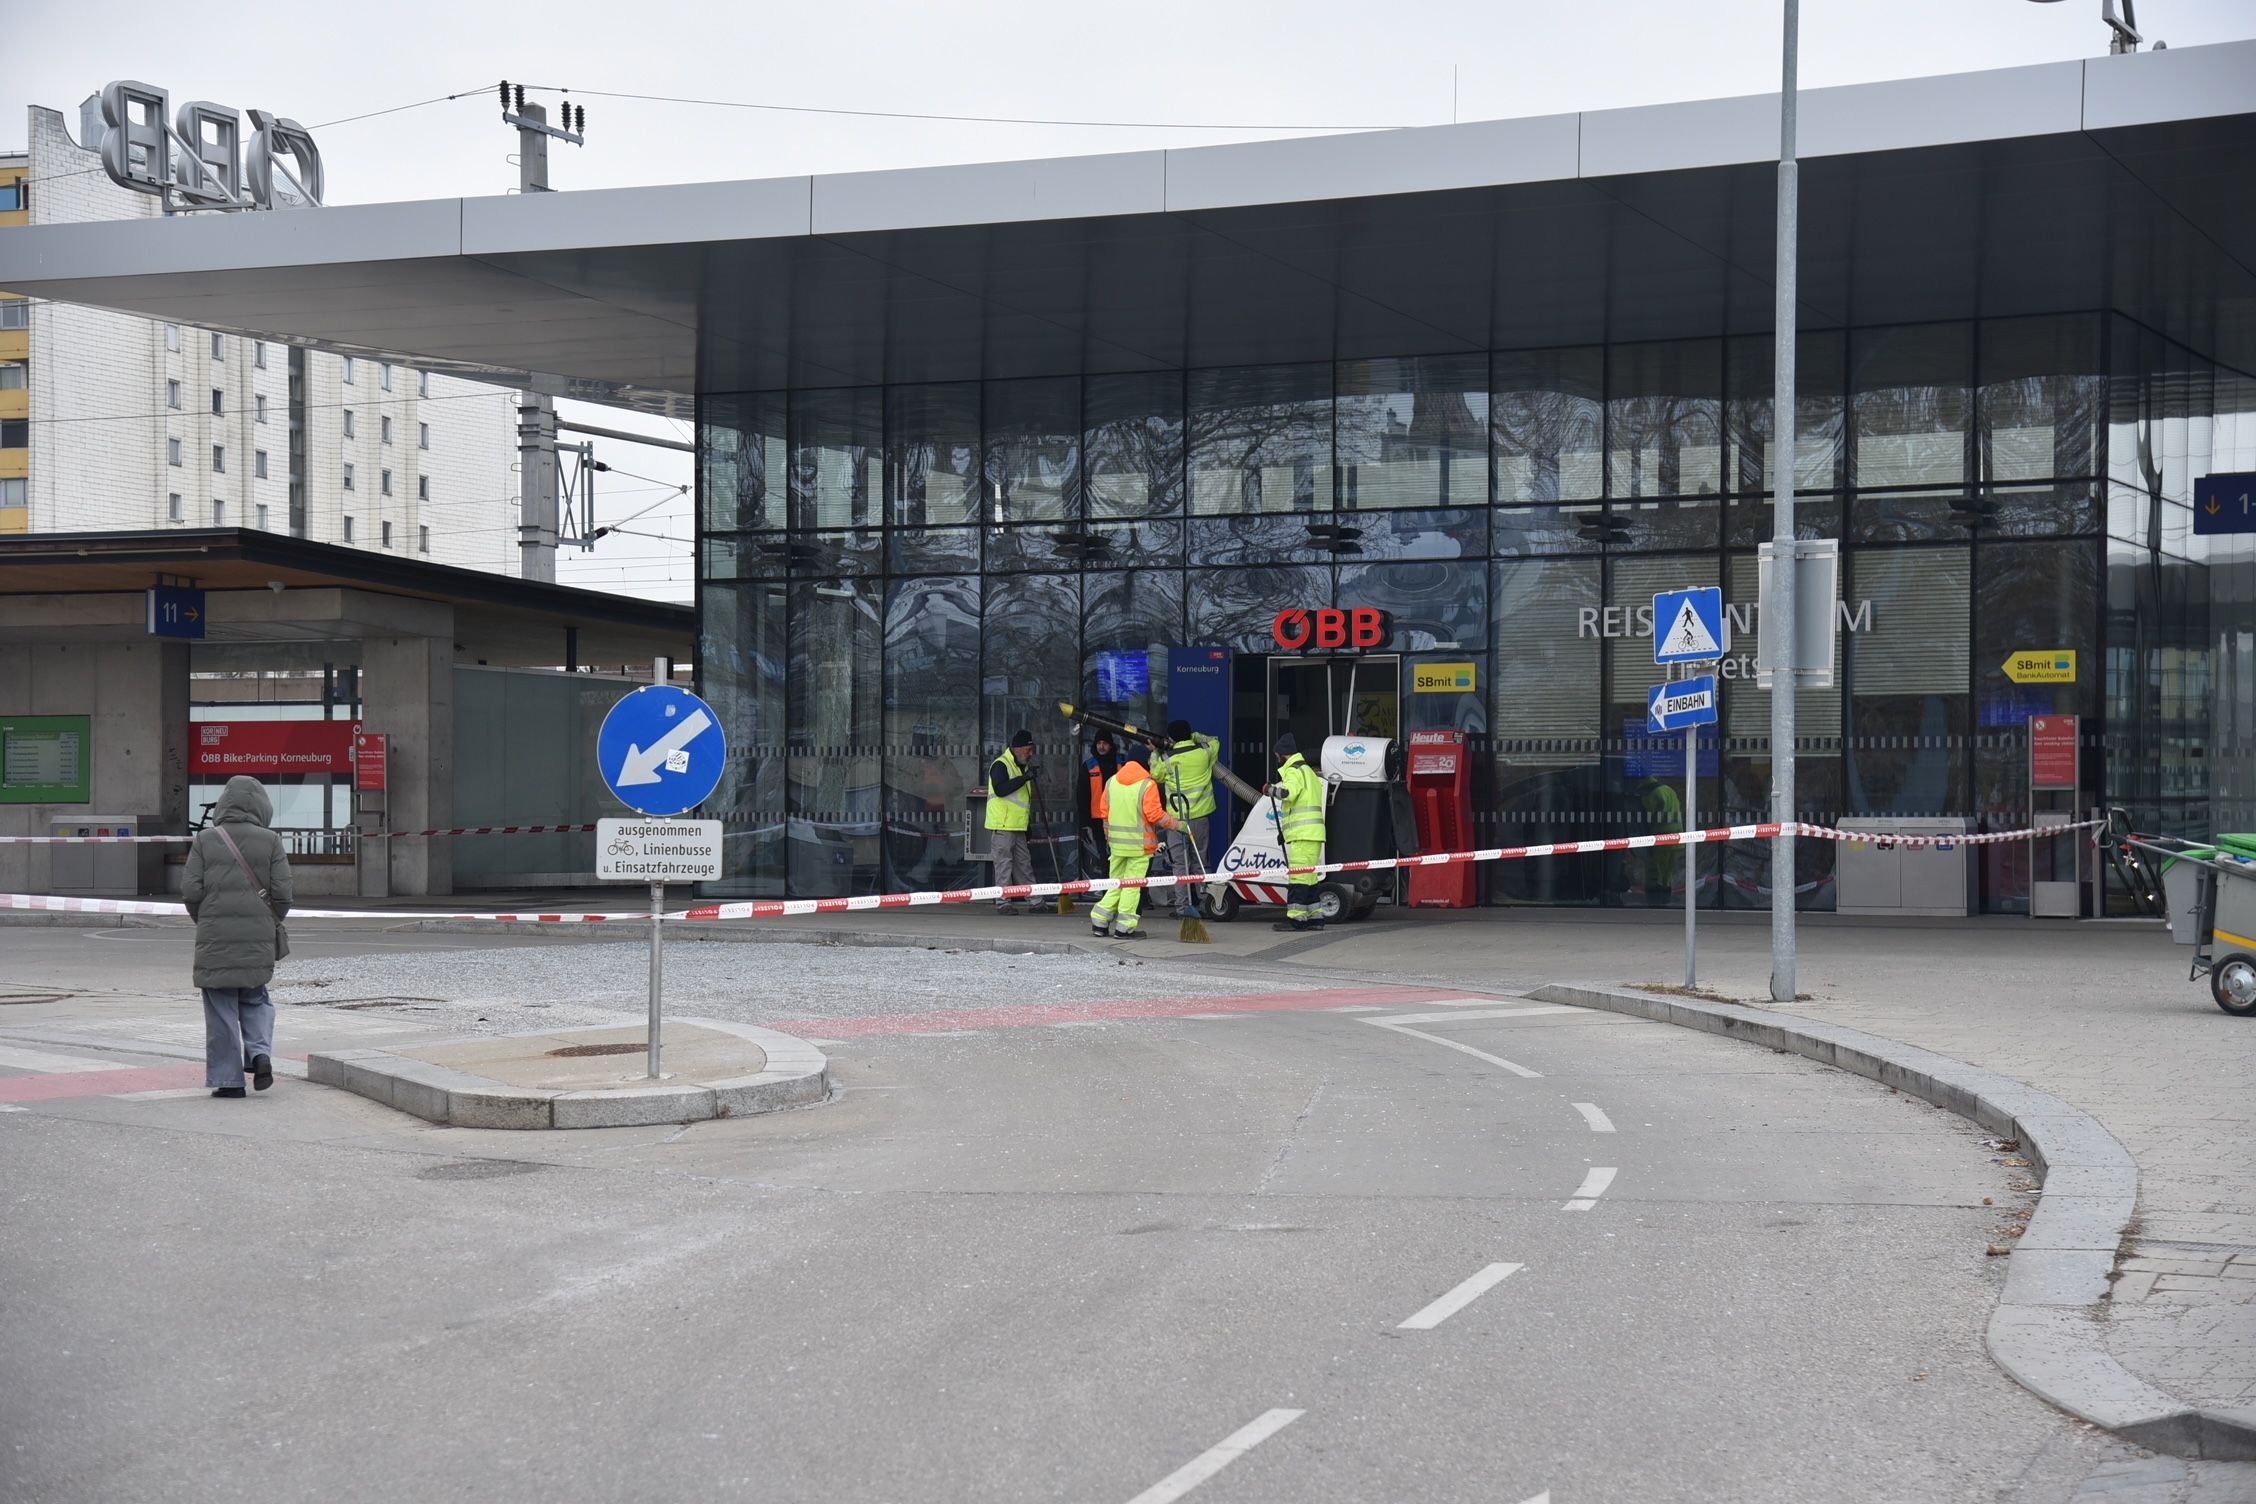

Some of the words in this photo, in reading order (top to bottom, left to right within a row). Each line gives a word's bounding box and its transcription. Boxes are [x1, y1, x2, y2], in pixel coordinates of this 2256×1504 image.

[162, 602, 178, 624] 11
[1177, 665, 1220, 675] Korneuburg
[2017, 660, 2051, 670] SBmit
[1417, 676, 1452, 687] SBmit
[1667, 693, 1705, 713] EINBAHN
[1412, 732, 1444, 743] Heute
[201, 751, 221, 763] ÖBB
[223, 752, 278, 765] Bike:Parking
[280, 752, 332, 765] Korneuburg
[618, 826, 702, 839] ausgenommen
[644, 843, 712, 856] Linienbusse
[1224, 845, 1287, 872] Glutton
[603, 864, 612, 873] u.
[615, 860, 715, 876] Einsatzfahrzeuge
